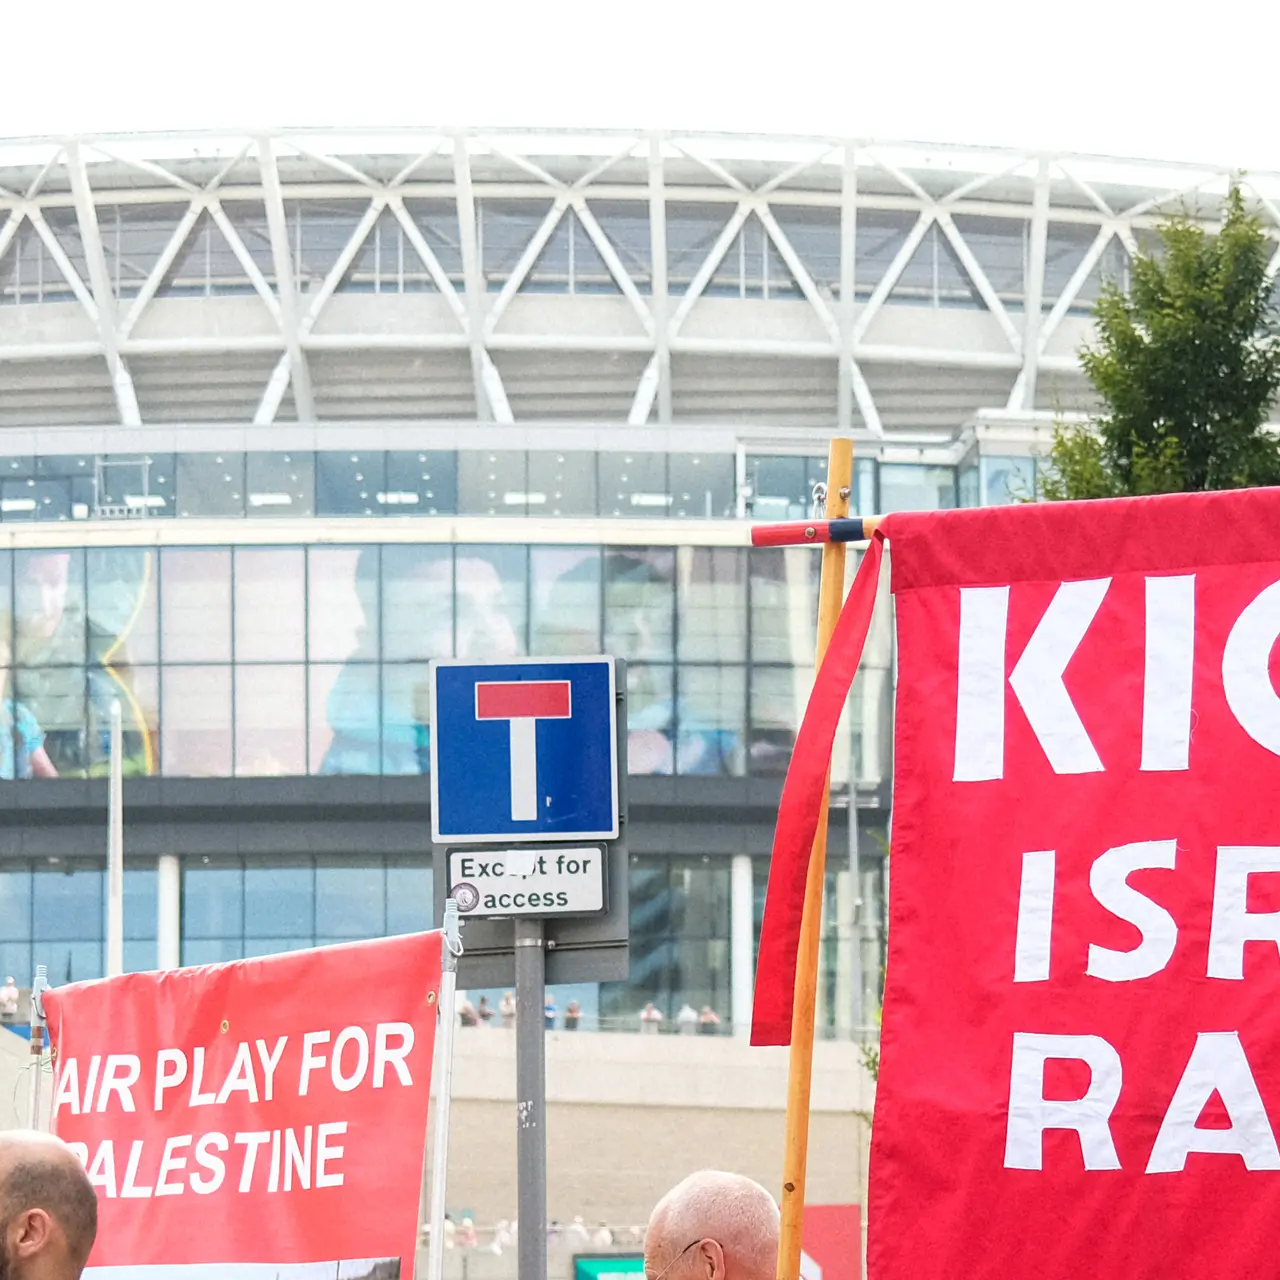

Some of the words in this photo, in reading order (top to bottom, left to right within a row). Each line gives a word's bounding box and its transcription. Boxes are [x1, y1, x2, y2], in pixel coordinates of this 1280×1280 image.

[461, 855, 547, 880] Exct
[556, 855, 592, 875] for
[484, 890, 569, 909] access
[53, 1053, 141, 1118] AIR
[154, 1035, 289, 1112] PLAY
[298, 1021, 416, 1097] FOR
